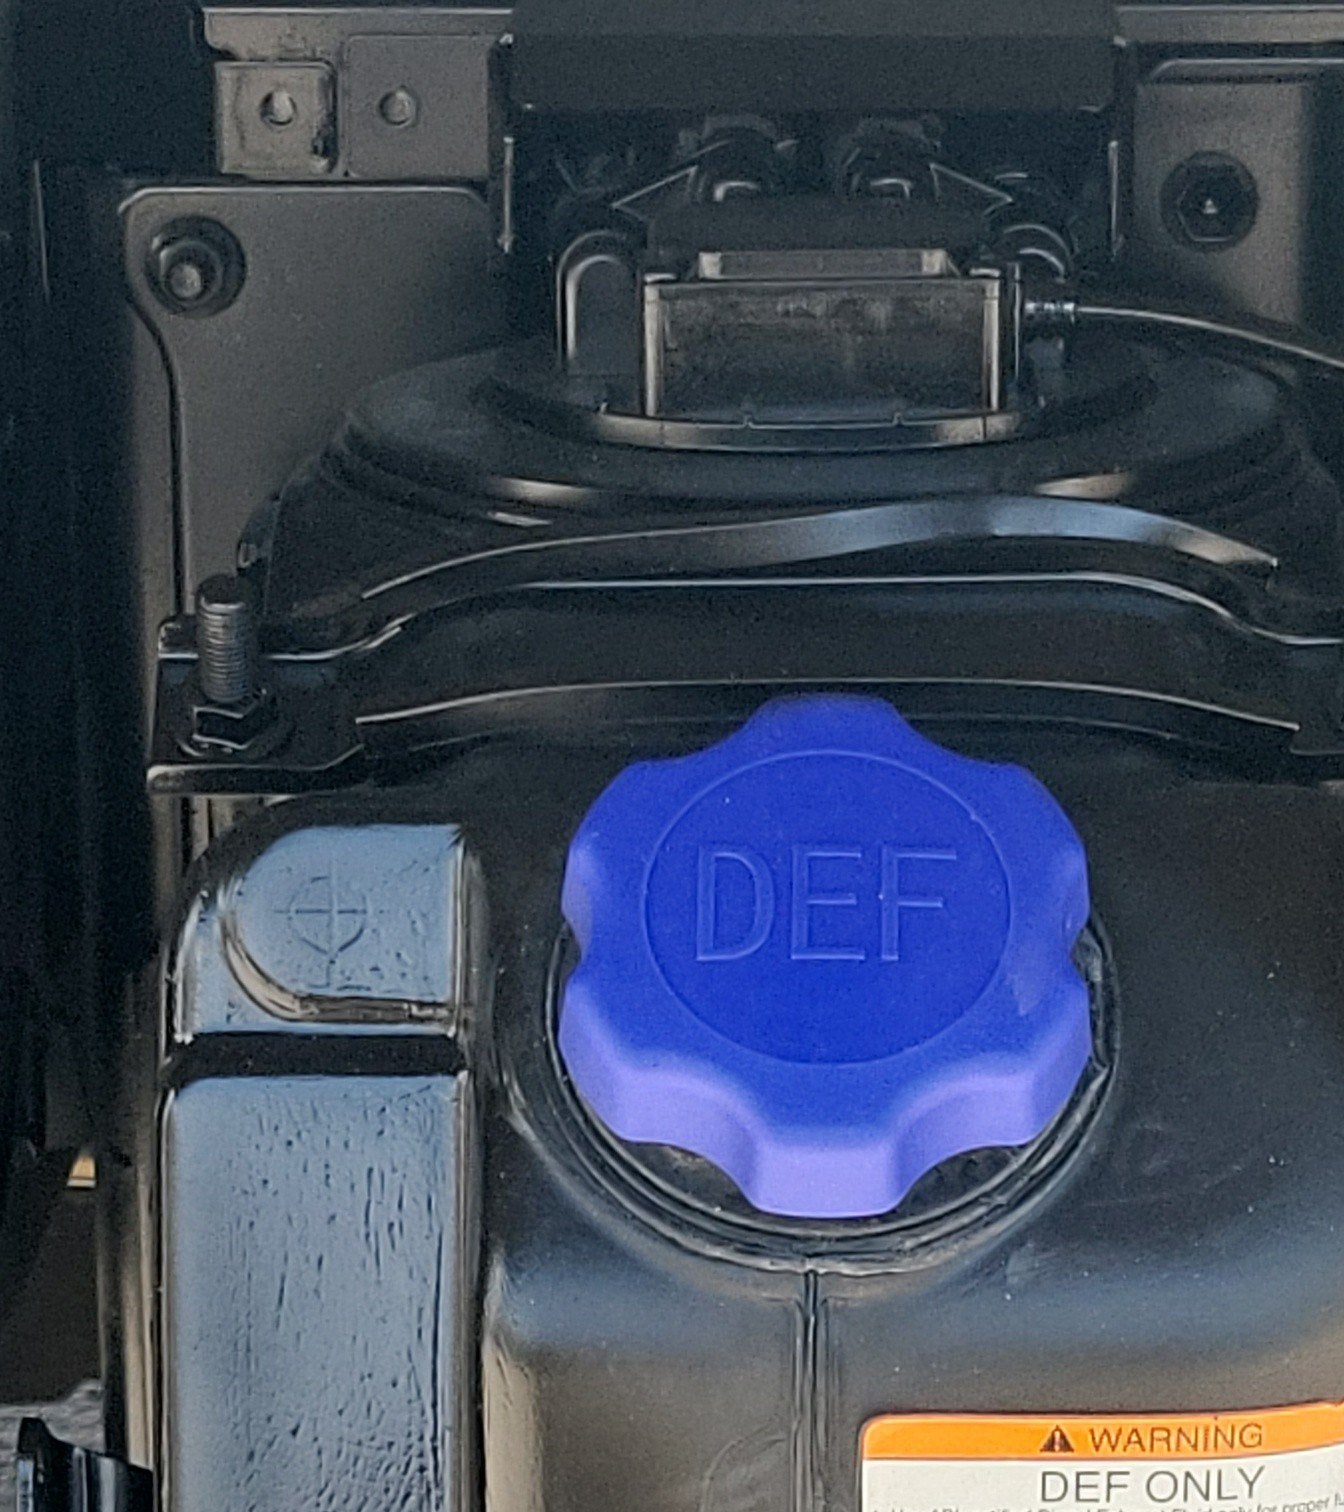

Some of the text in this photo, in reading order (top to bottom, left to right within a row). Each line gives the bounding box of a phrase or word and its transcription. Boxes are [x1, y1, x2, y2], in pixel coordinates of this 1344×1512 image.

[696, 844, 956, 962] DEF
[1088, 1423, 1263, 1453] WARNING
[1040, 1465, 1266, 1503] DEF ONLY
